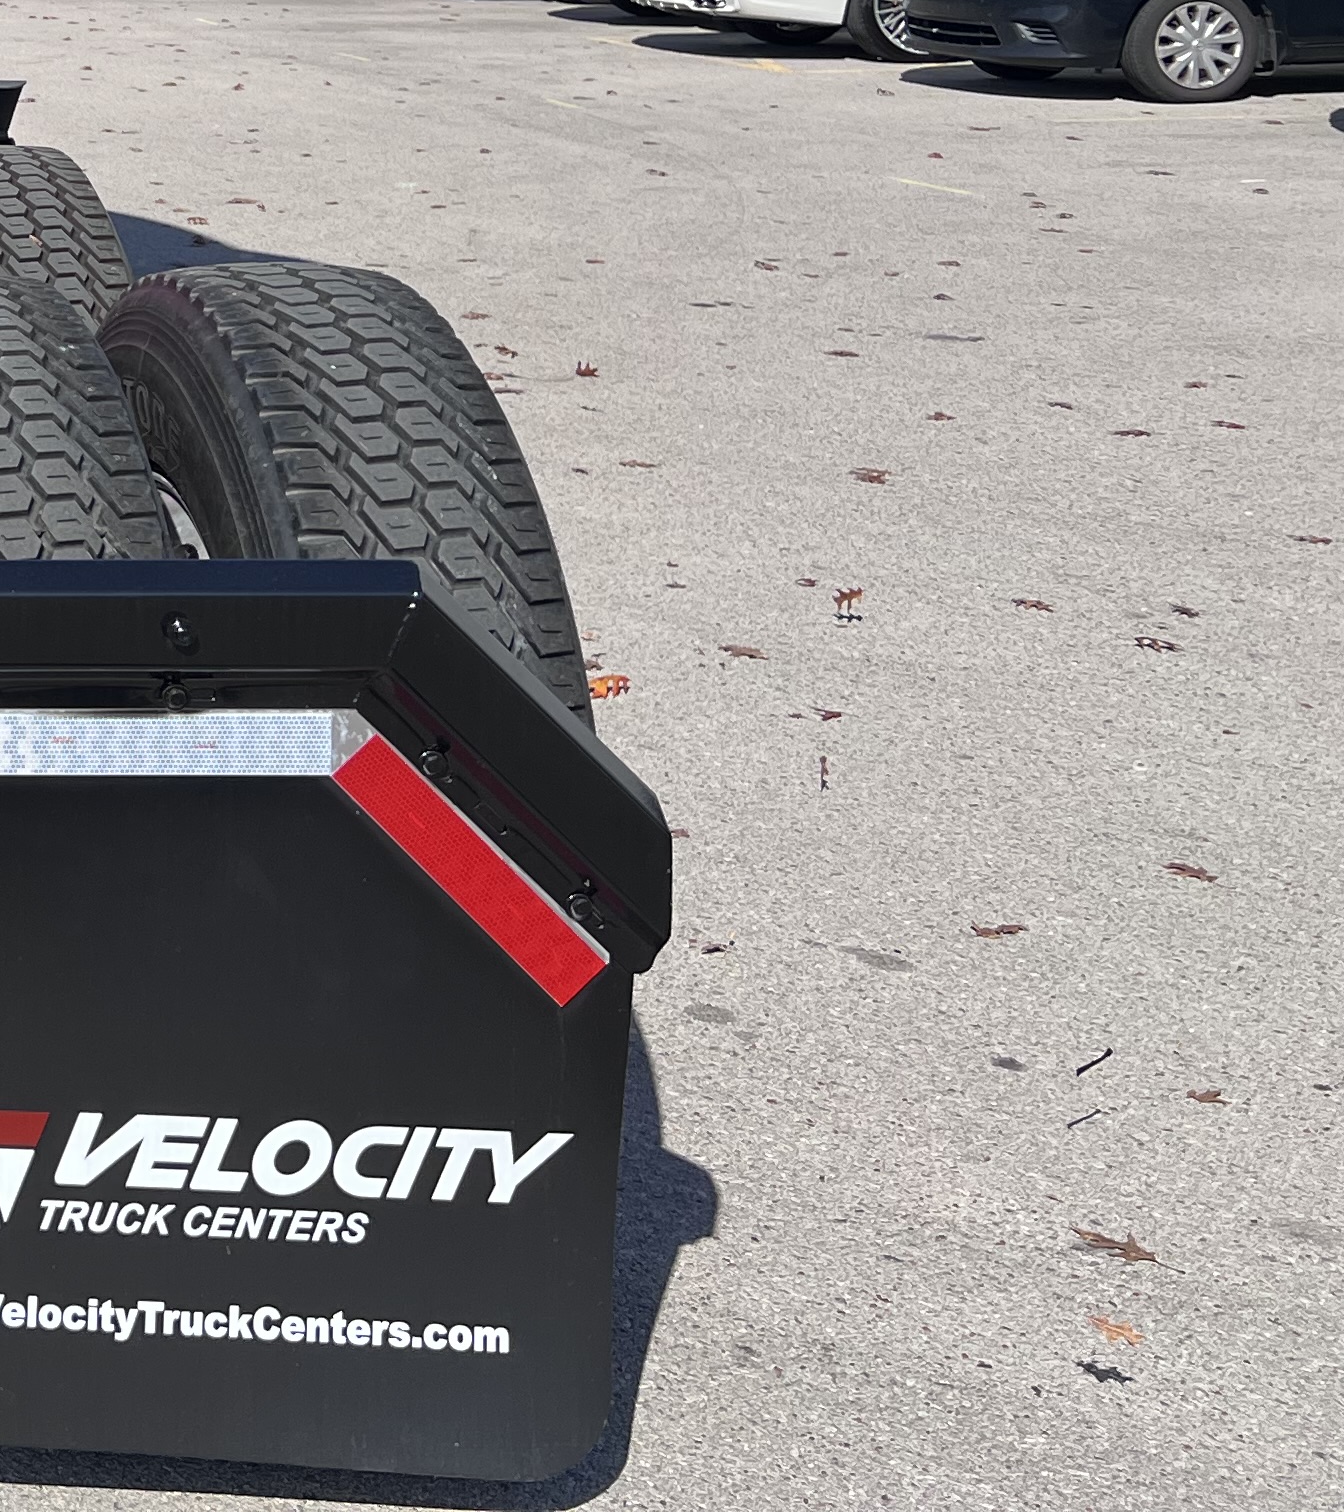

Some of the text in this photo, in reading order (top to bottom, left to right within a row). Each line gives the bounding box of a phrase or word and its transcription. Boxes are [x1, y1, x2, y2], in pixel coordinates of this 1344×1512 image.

[54, 1111, 575, 1205] VELOCITY
[39, 1199, 370, 1245] TRUCK CENTERS
